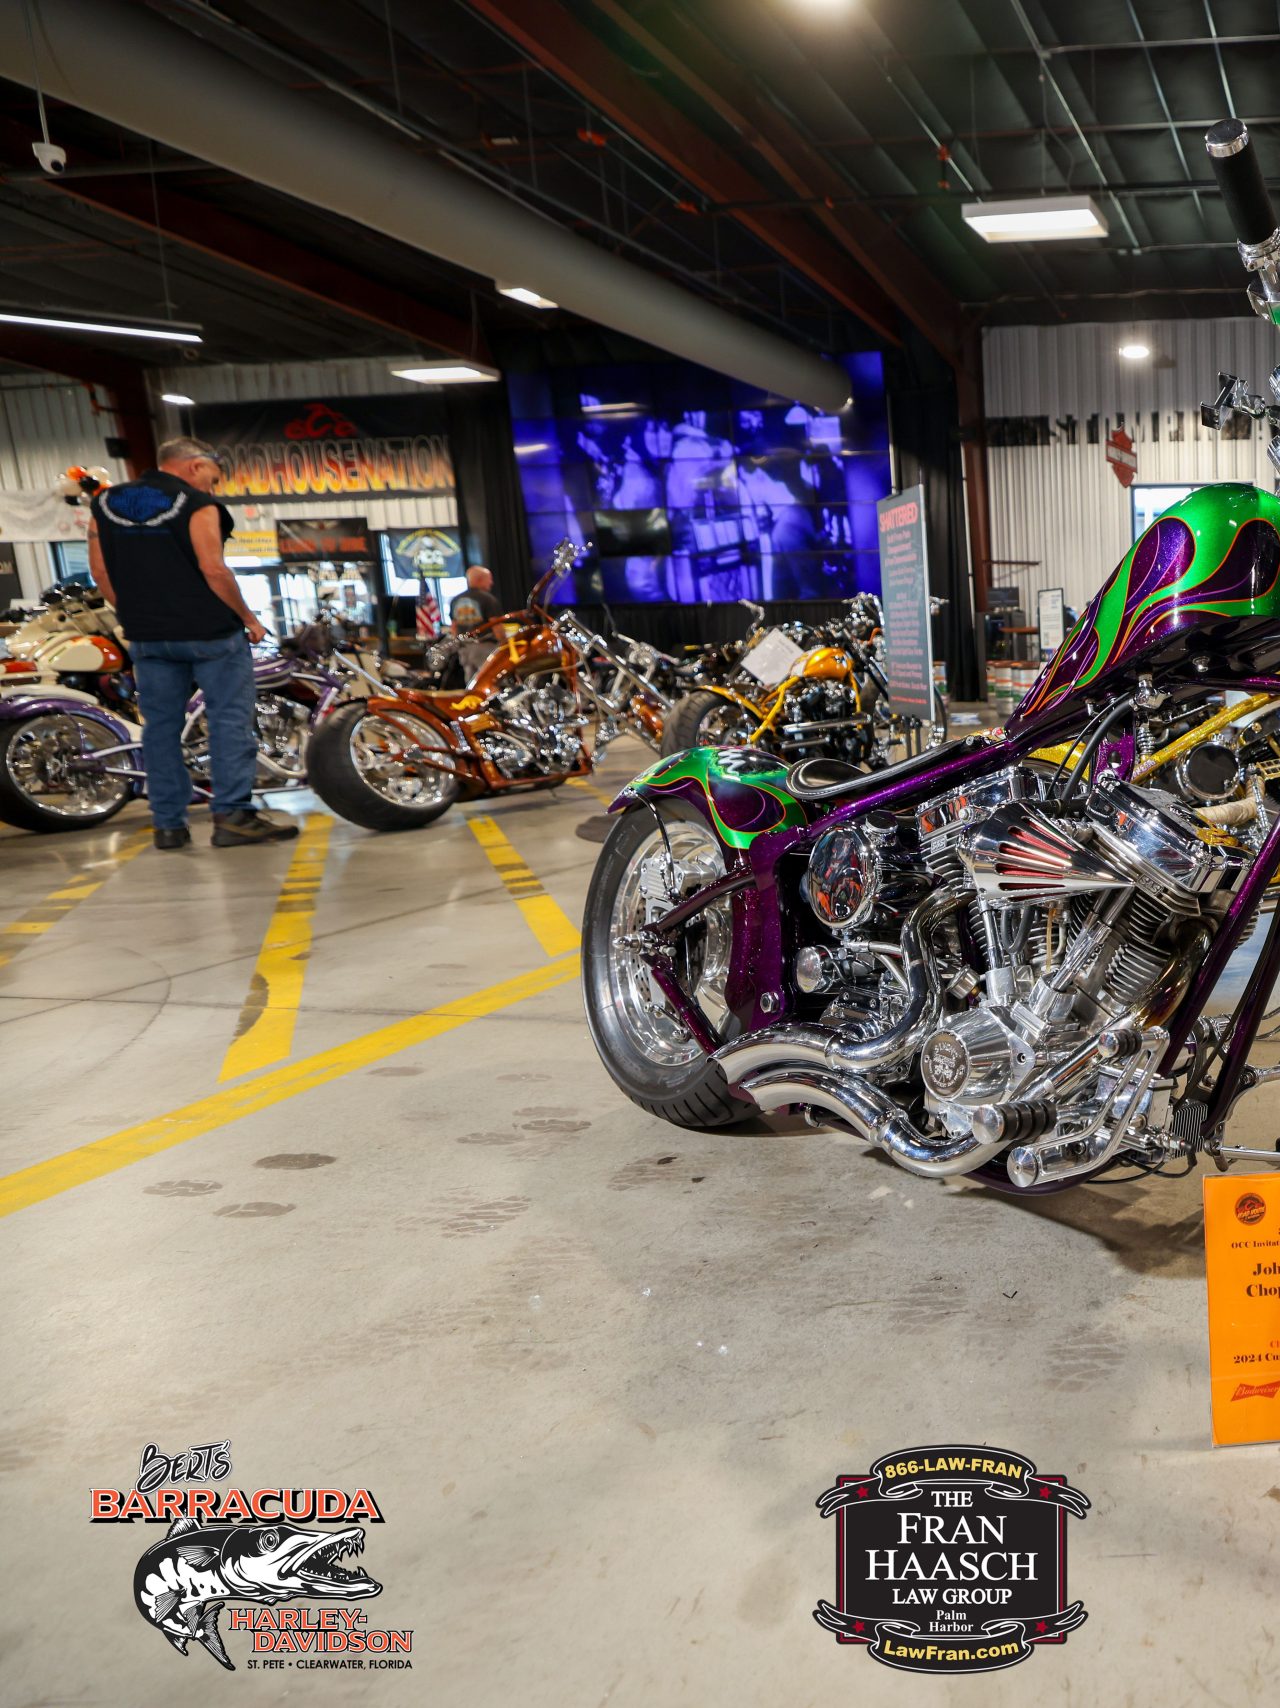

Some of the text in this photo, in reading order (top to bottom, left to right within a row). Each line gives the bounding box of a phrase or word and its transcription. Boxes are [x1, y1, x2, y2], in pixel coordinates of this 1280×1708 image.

[880, 502, 918, 532] SHATTERED
[1231, 1241, 1251, 1249] OCC
[1233, 1353, 1262, 1364] 2024
[1235, 1386, 1280, 1396] Budweiser
